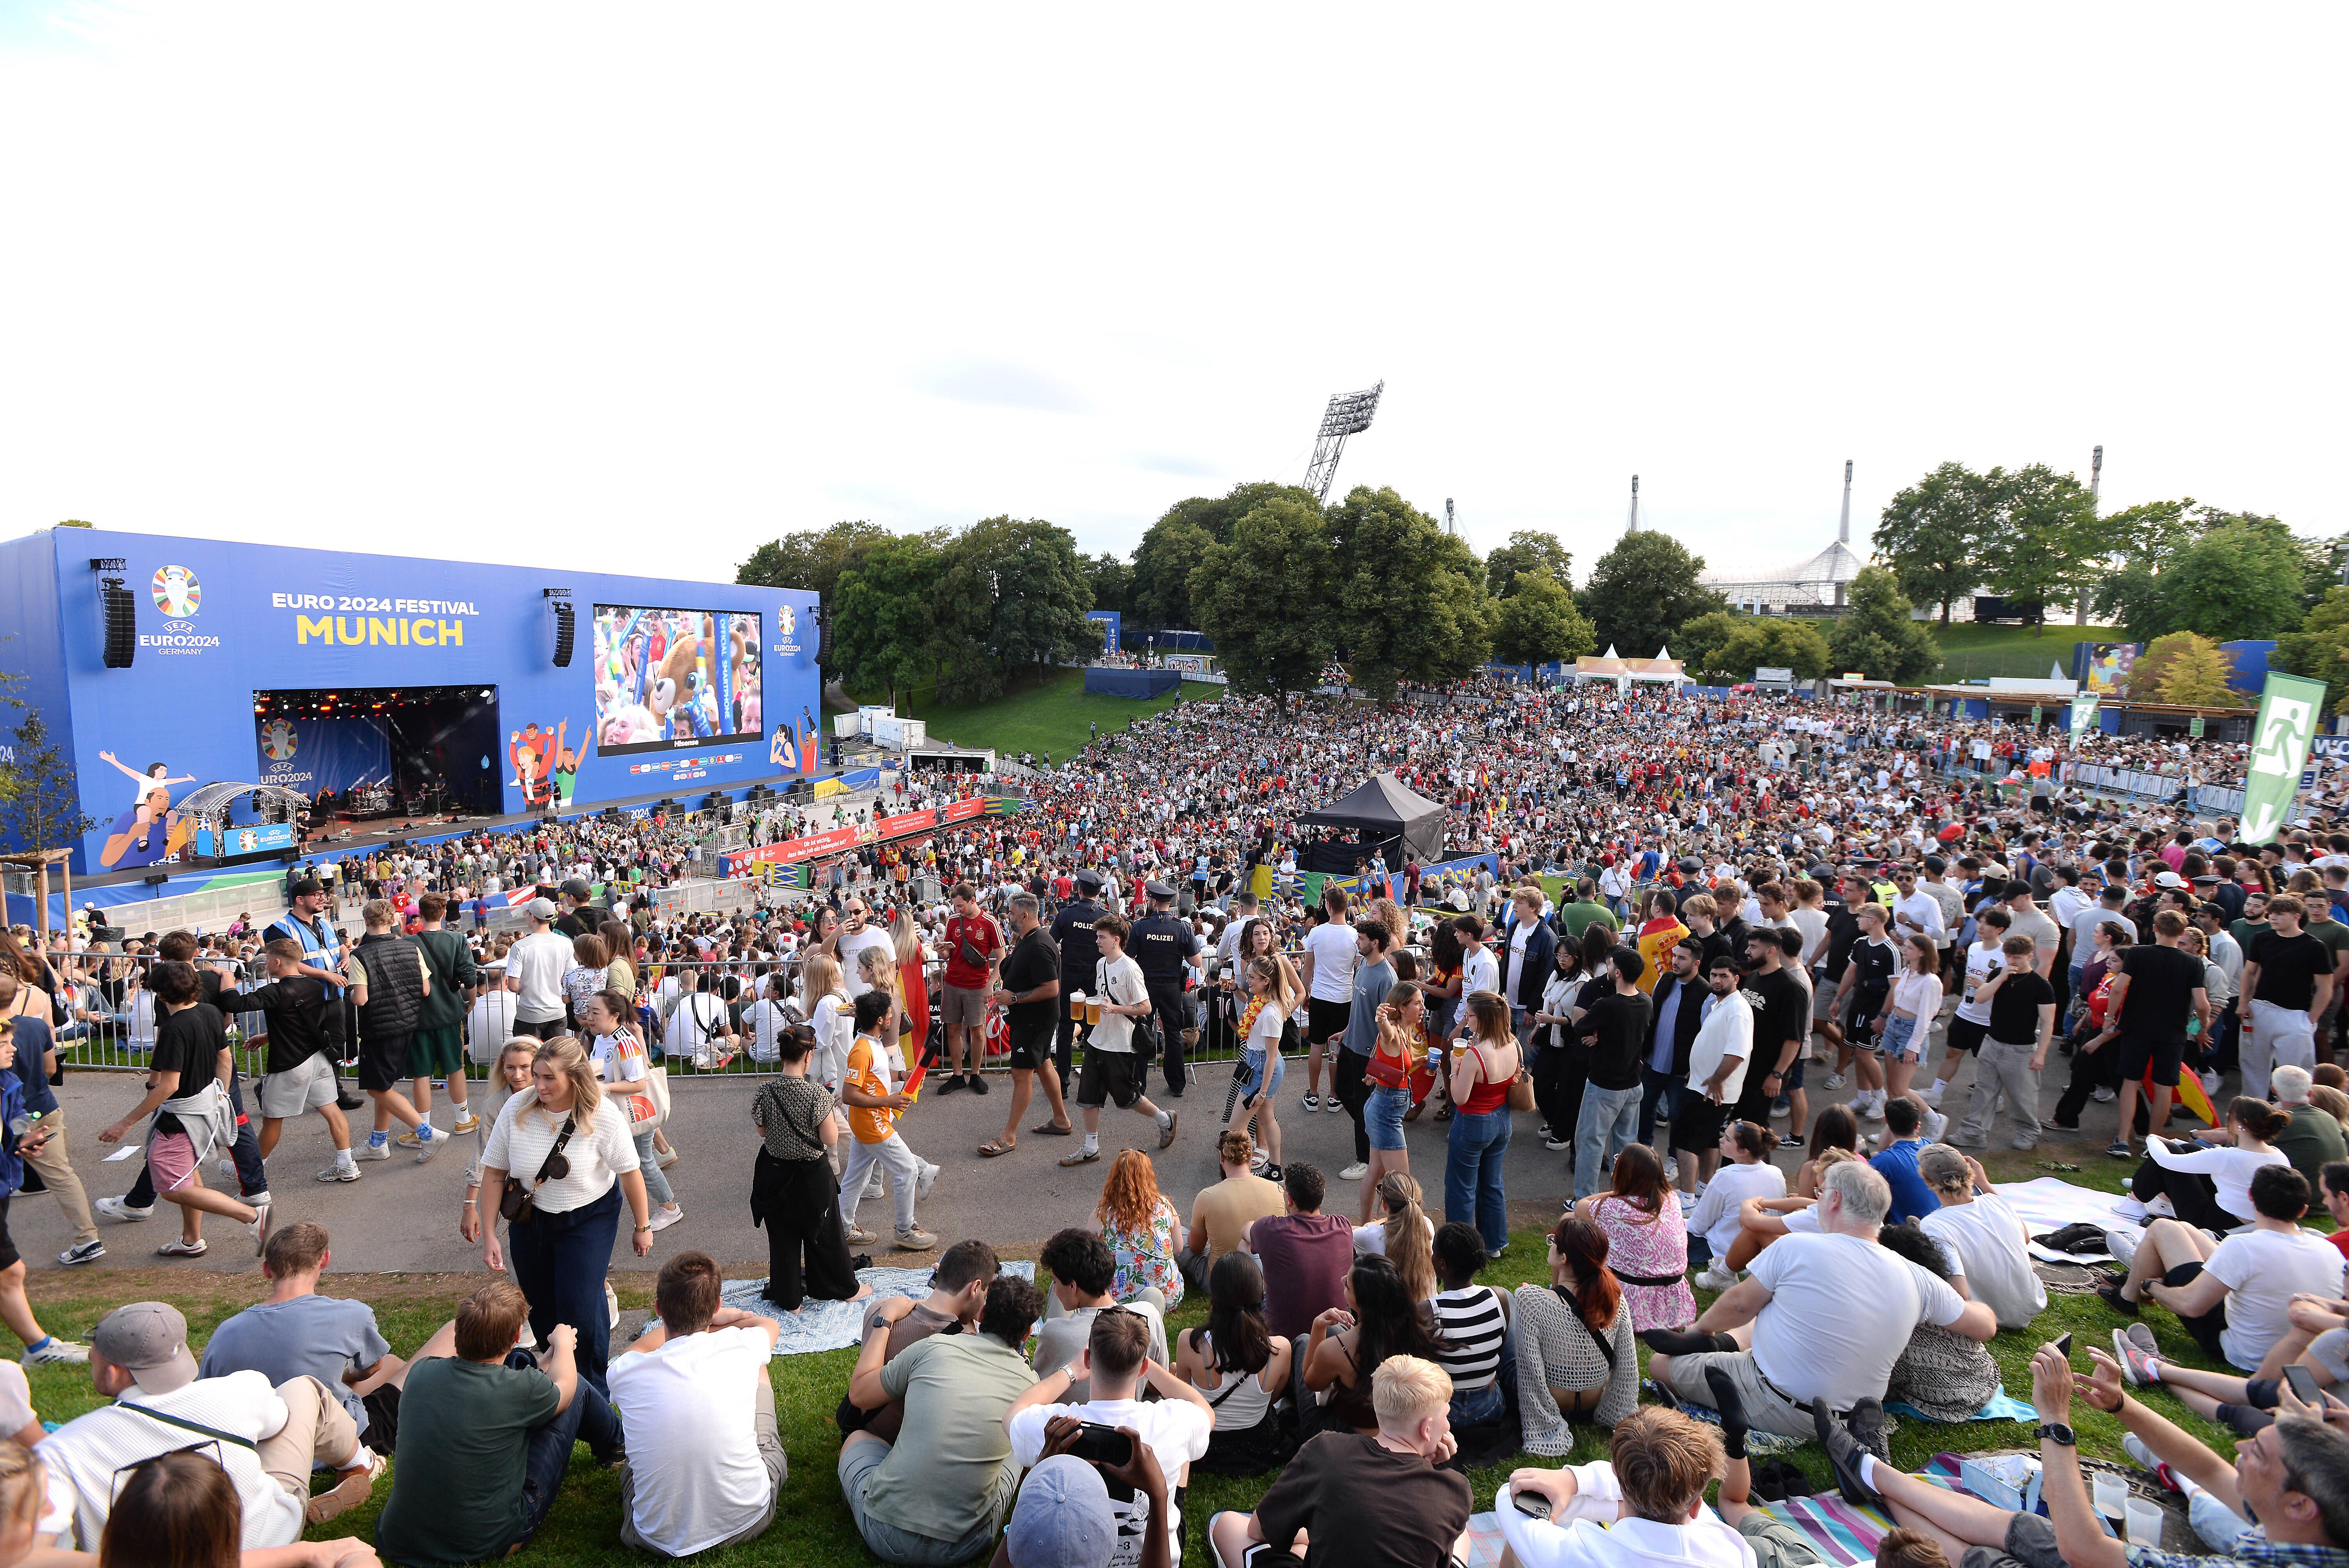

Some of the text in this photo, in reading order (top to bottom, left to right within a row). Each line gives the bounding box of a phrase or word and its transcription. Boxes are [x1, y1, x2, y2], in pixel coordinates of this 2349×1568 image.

[272, 592, 480, 615] EURO 2024 FESTIVAL
[163, 623, 193, 634] UEFA
[296, 615, 464, 646] MUNICH
[140, 634, 220, 647] EURO2024
[722, 659, 730, 720] SMARTPHONE
[674, 739, 699, 747] Hisense
[0, 745, 15, 763] 24
[271, 764, 292, 772] UEFA
[260, 772, 312, 784] URO2024
[260, 834, 291, 843] EURO2024
[821, 840, 839, 850] Heimspiel
[1073, 921, 1093, 930] POLIZ
